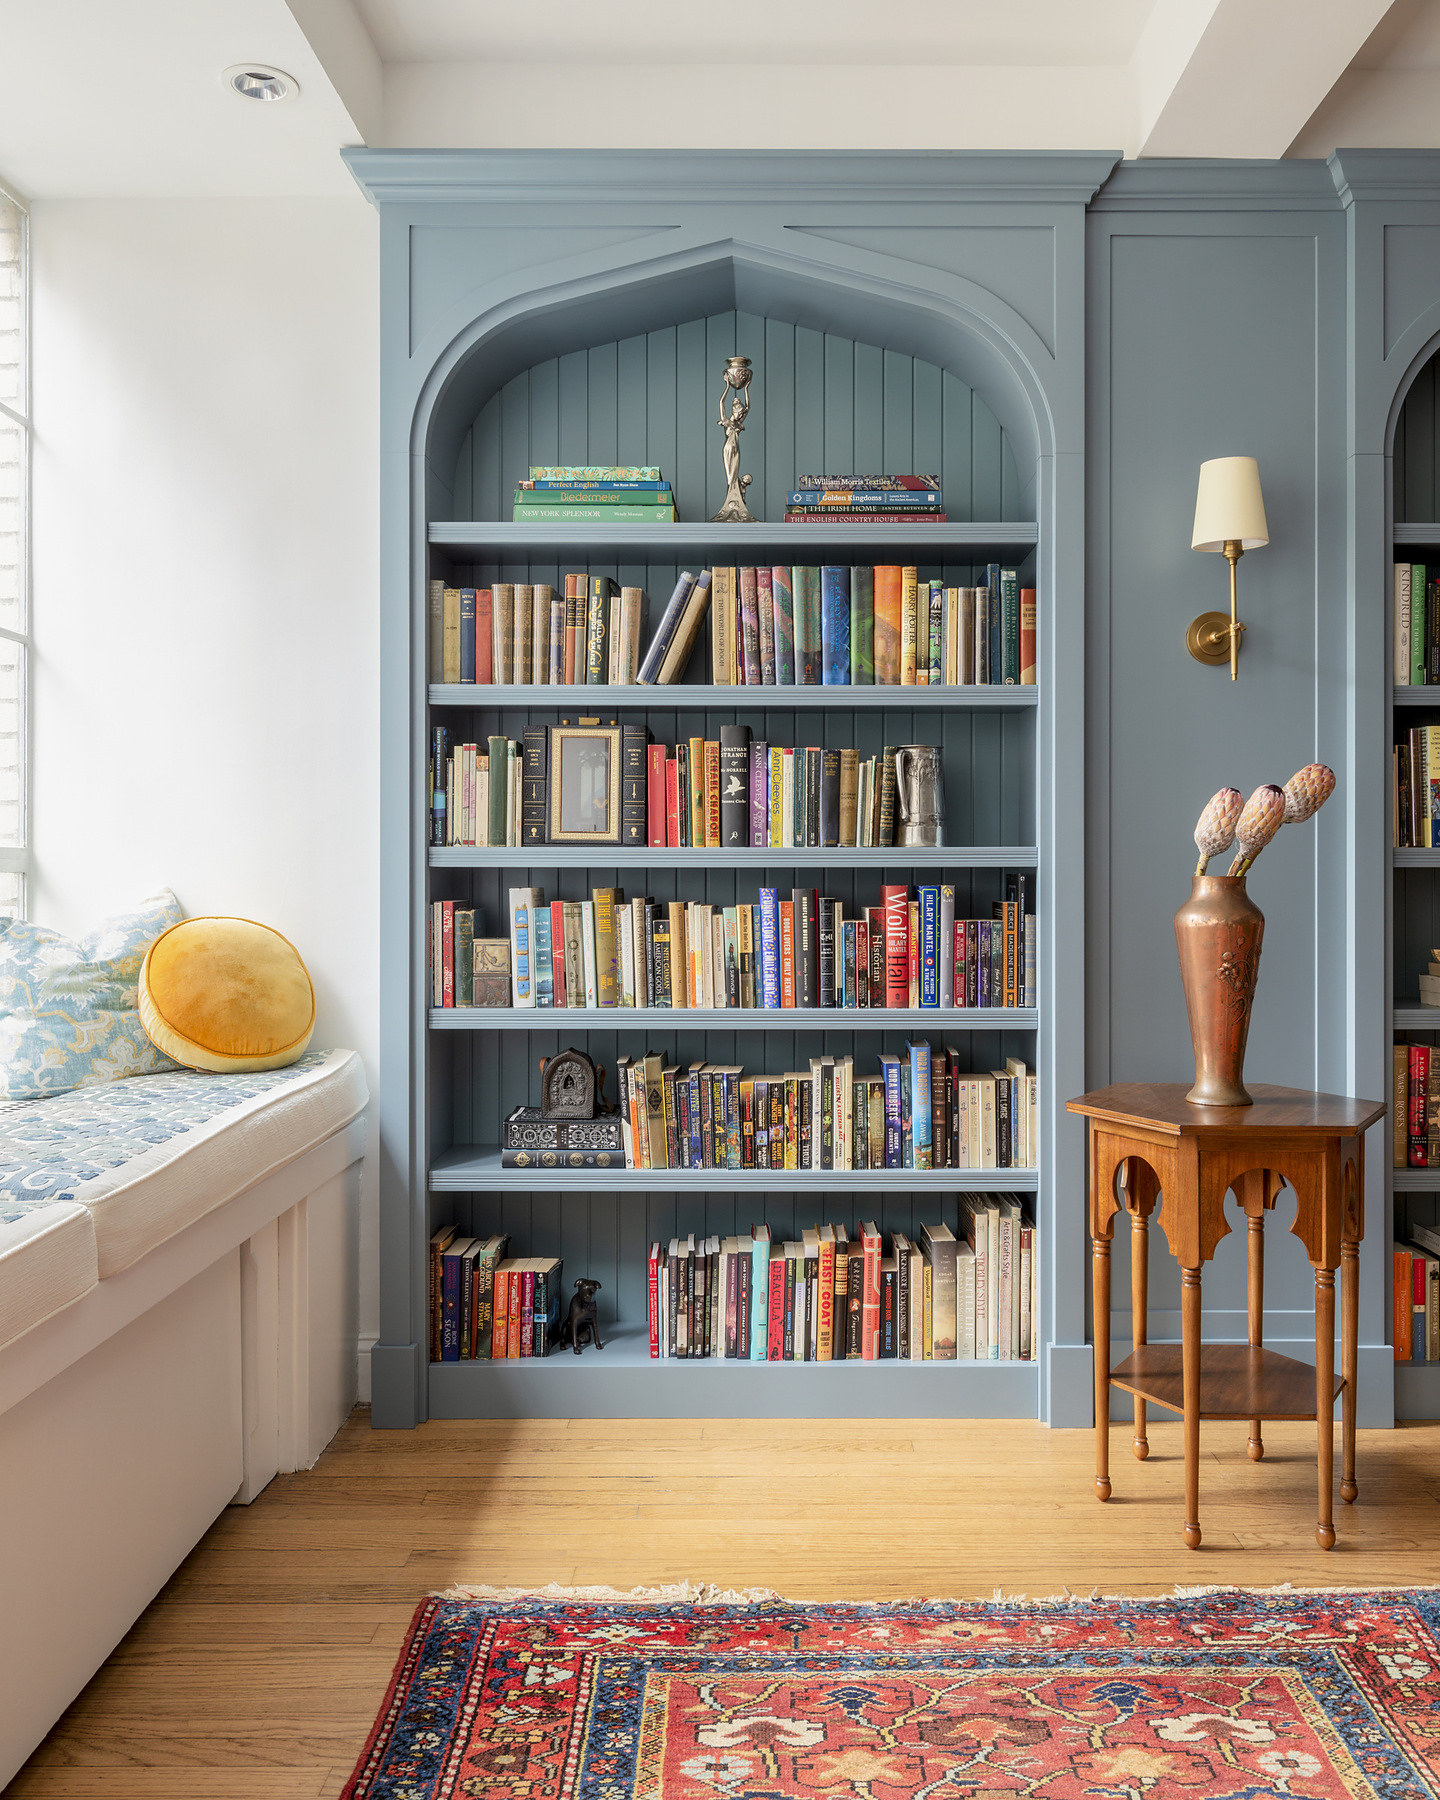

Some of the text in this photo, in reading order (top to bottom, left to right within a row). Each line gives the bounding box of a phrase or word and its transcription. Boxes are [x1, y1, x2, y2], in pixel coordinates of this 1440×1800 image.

[1401, 569, 1410, 629] KINDRED
[719, 638, 724, 647] OF
[710, 747, 719, 838] MICHAEL CHABON
[773, 751, 781, 815] Ann Cleeves
[597, 894, 611, 933] TO THE HILT
[925, 895, 934, 954] HILARY MANTEL
[763, 896, 775, 995] FUNNY STORY EMILY HENRY
[872, 935, 882, 982] Historian
[887, 891, 907, 989] Wolf Hall
[917, 1051, 927, 1071] NORA
[888, 1069, 898, 1121] NORA ROBERTS
[917, 1074, 928, 1106] ROBERTS
[1395, 1100, 1405, 1127] ROSES
[822, 1253, 832, 1284] FEAST
[1001, 1262, 1010, 1279] Style
[772, 1266, 782, 1321] DRACULA
[822, 1291, 830, 1327] GOAT
[965, 1276, 974, 1314] LITTLE
[977, 1293, 986, 1319] STYLE
[444, 1319, 452, 1348] SEASON
[965, 1316, 974, 1338] LIFE
